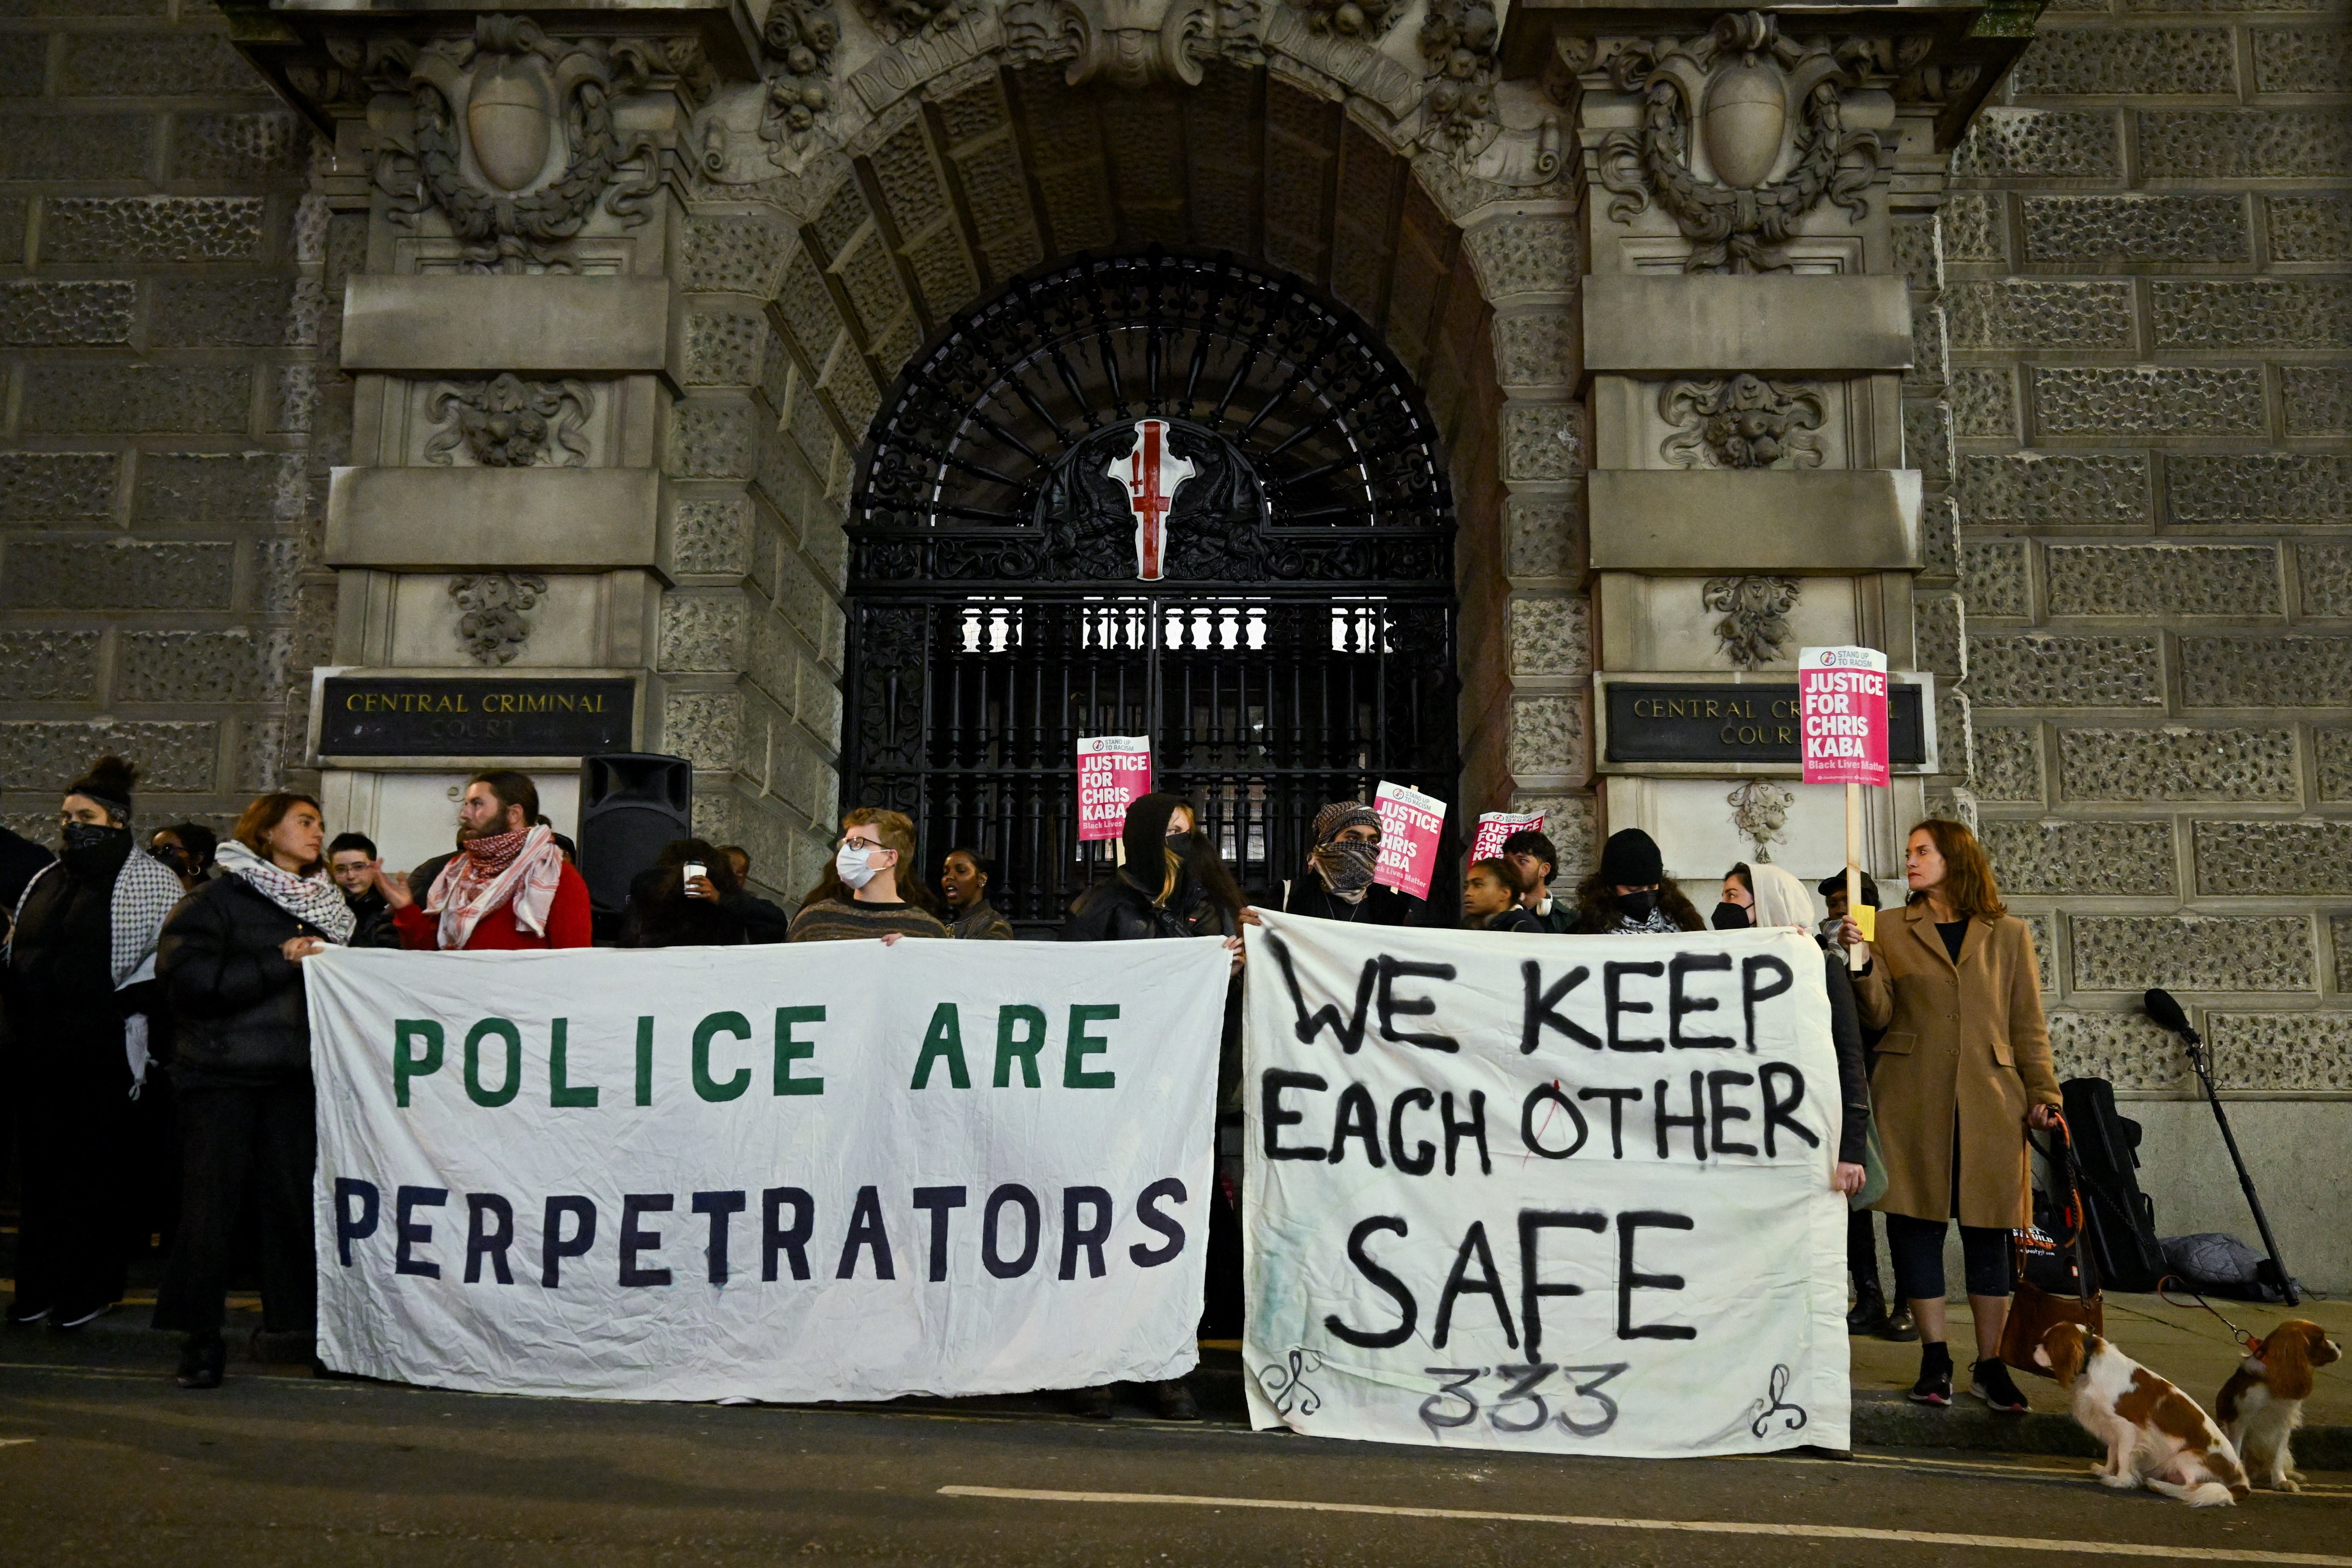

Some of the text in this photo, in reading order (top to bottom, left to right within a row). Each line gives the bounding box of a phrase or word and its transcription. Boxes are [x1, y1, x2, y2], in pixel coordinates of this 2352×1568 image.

[1838, 650, 1859, 659] STAND
[1850, 659, 1872, 667] RACISM
[1805, 672, 1884, 696] JUSTICE
[347, 694, 607, 712] CENTRAL CRIMINAL
[1634, 699, 1757, 718] CENTRAL
[1806, 694, 1849, 715] FOR
[1806, 715, 1869, 736] CHRIS
[1807, 737, 1865, 758] KABA
[1081, 755, 1147, 772] JUSTICE
[1808, 759, 1885, 772] Black Lives Matter
[1081, 772, 1113, 788] FOR
[1082, 787, 1130, 804] CHRIS
[1405, 791, 1421, 801] STAND
[1412, 799, 1431, 811] RACISM
[1083, 803, 1127, 821] KABA
[1377, 800, 1440, 834] JUSTICE
[1380, 817, 1406, 837] OR
[1377, 833, 1417, 857] HRIS
[1477, 832, 1507, 844] FOR
[1377, 850, 1409, 872] ABA
[1386, 867, 1404, 879] Lives
[1404, 874, 1427, 888] Matter
[1262, 928, 1794, 1054] WE KEEP
[393, 1003, 1120, 1108] POLICE ARE
[1262, 1062, 1820, 1176] EACH OTHER
[334, 1177, 1188, 1290] PERPETRATORS
[1324, 1208, 1696, 1365] SAFE
[1419, 1364, 1629, 1438] 333
